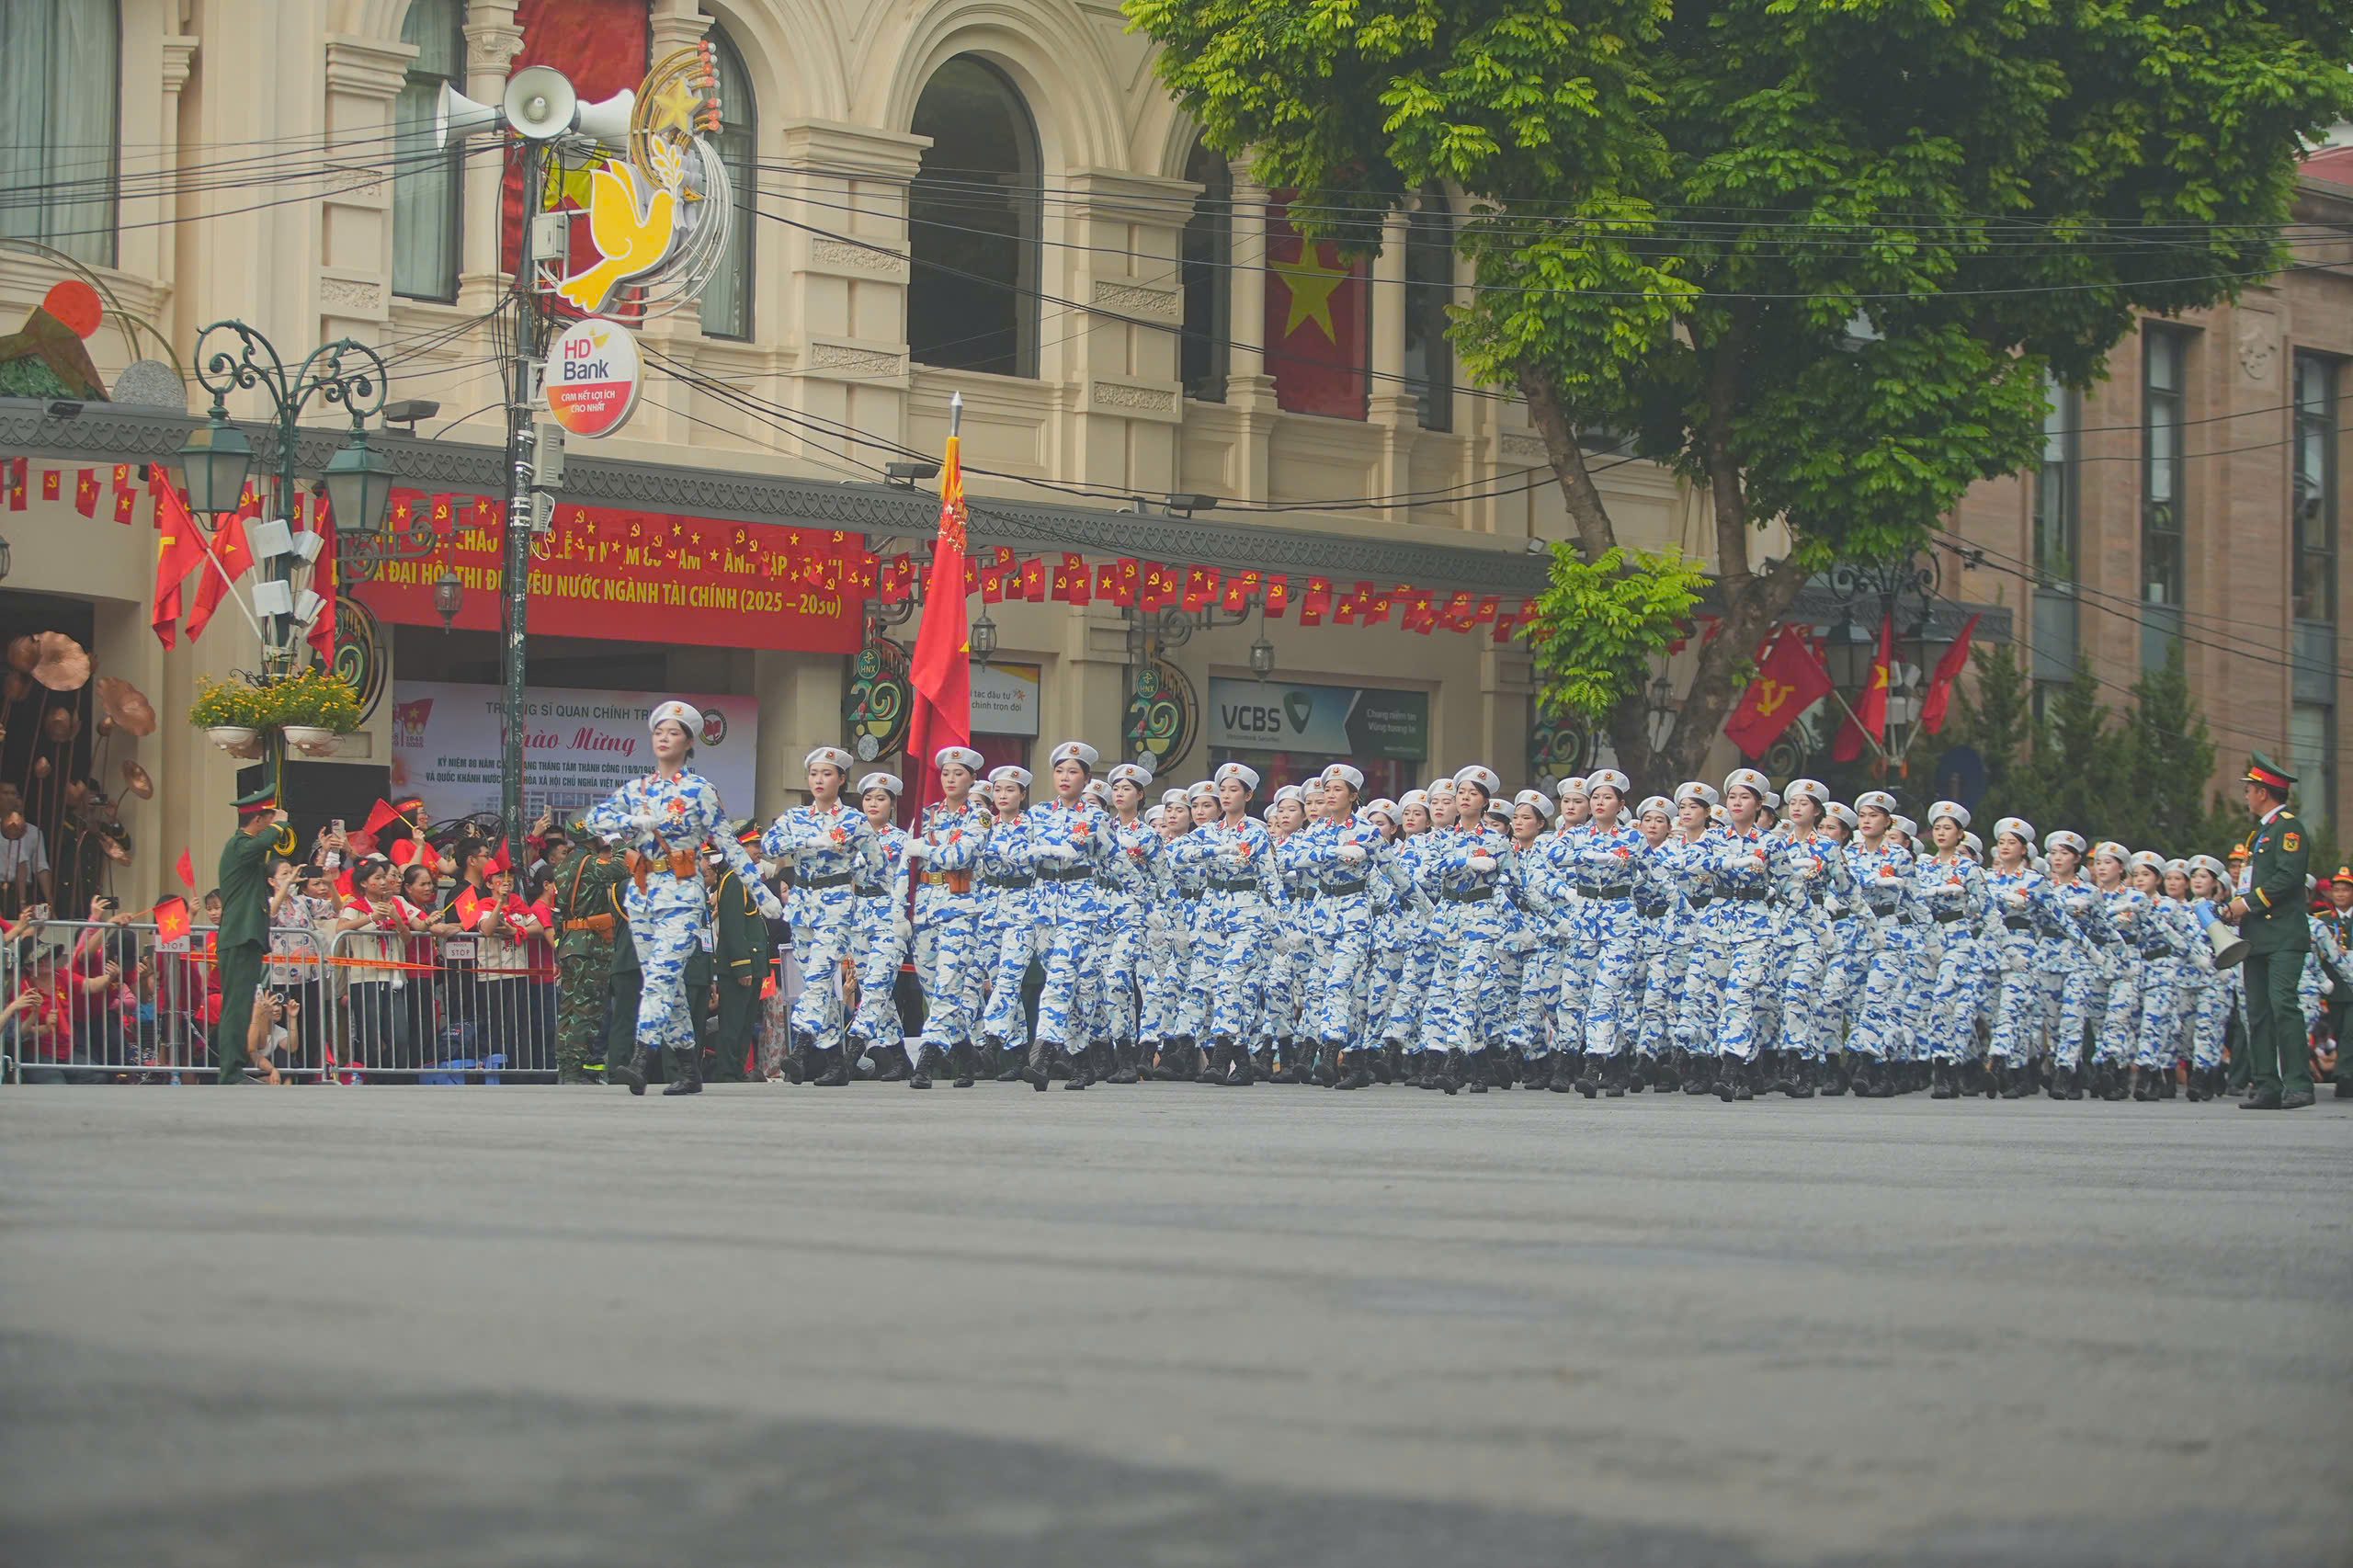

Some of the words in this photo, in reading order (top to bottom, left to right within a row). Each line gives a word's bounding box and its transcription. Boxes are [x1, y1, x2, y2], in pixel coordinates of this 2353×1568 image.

[564, 338, 592, 359] HD
[563, 359, 609, 381] Bank
[561, 392, 577, 402] CAM
[577, 390, 590, 401] KẾT
[591, 391, 603, 402] LỢI
[604, 390, 616, 399] ÍCH
[571, 403, 586, 413] CAO
[586, 401, 606, 412] NHẤT
[388, 560, 417, 590] ĐẠI
[455, 565, 483, 590] THI
[556, 573, 601, 600] NƯỚC
[604, 577, 659, 604] NGÀNH
[662, 580, 687, 607] TÀI
[689, 582, 737, 609] CHÍNH
[740, 587, 783, 613] (2025
[860, 665, 876, 674] HNX
[1139, 684, 1154, 692] HNX
[540, 701, 552, 716] SĨ
[556, 705, 589, 719] QUAN
[593, 705, 630, 720] CHÍNH
[1221, 704, 1281, 733] VCBS
[566, 726, 637, 757] Mừng
[539, 760, 561, 772] THÁNG
[601, 762, 620, 774] CÔNG
[457, 772, 481, 783] KHÁNH
[483, 772, 502, 784] NƯỚC
[451, 949, 471, 957] STOP
